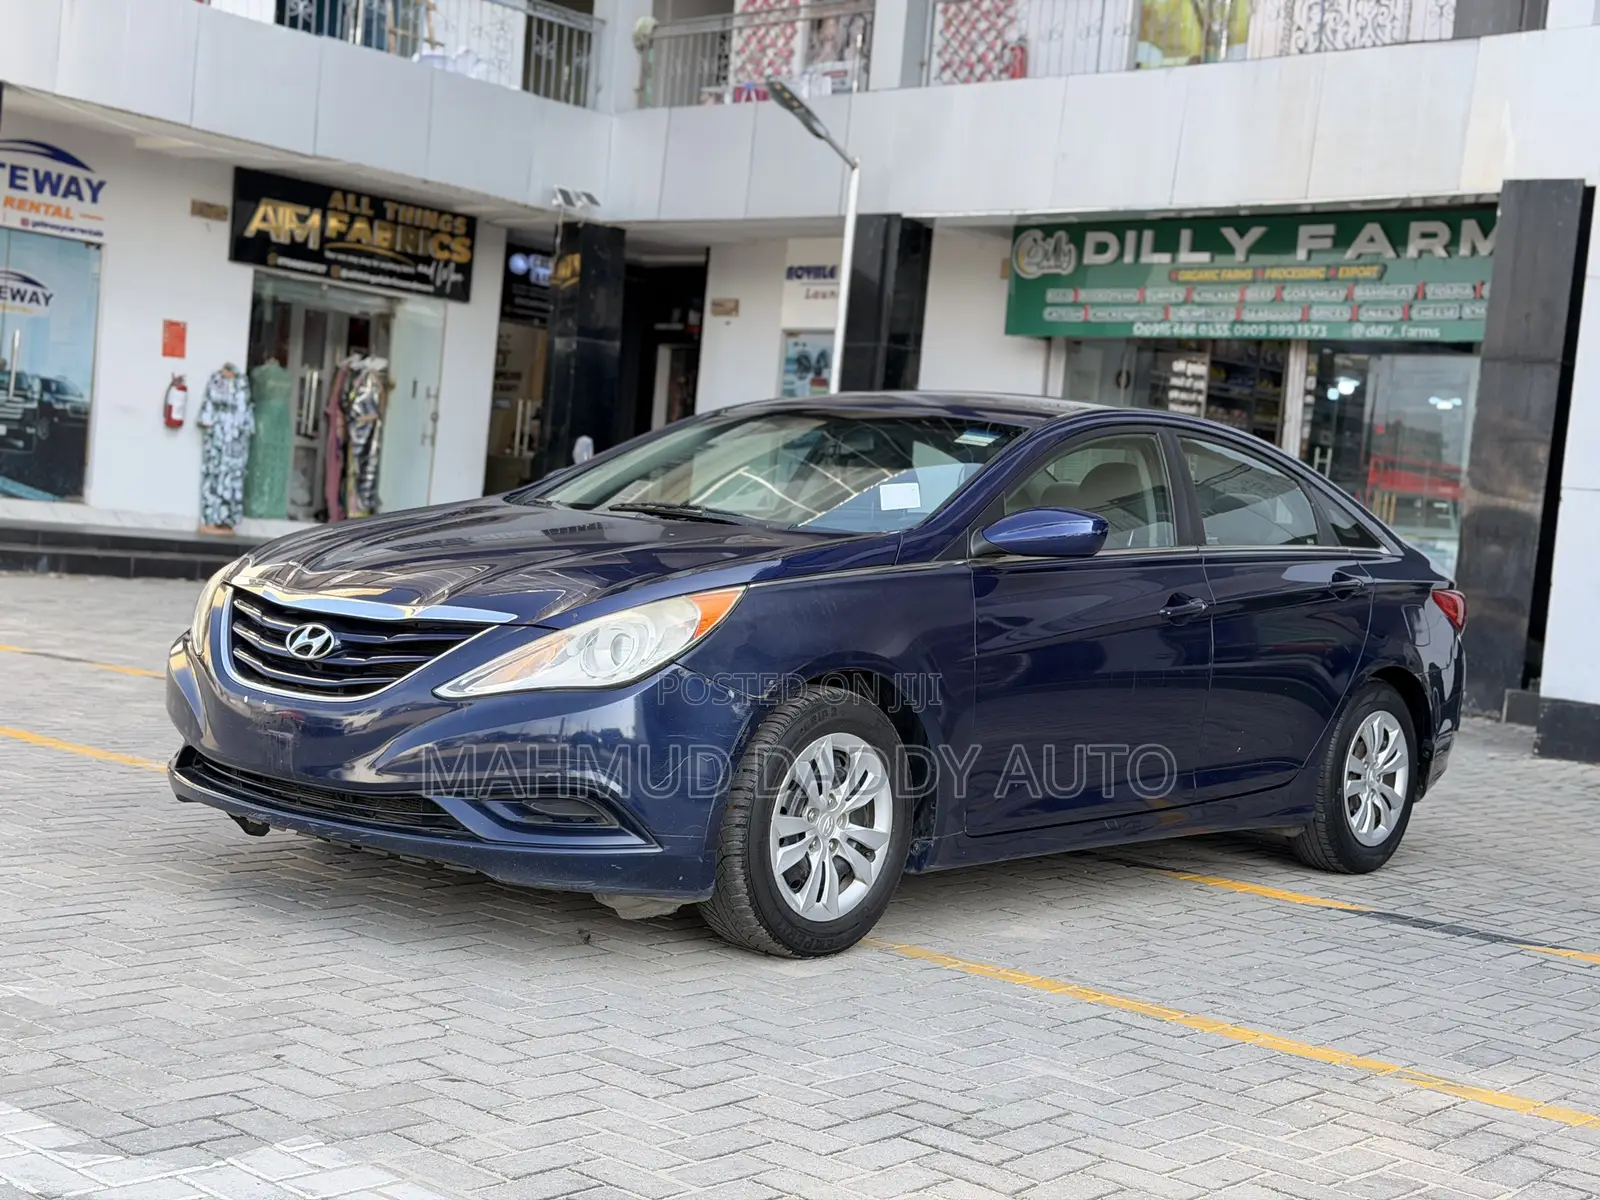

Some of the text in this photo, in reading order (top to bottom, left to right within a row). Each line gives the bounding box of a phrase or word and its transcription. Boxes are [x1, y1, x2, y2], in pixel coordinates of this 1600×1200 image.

[3, 194, 74, 221] RENTAL
[328, 190, 468, 235] ALL THINGS
[324, 210, 471, 263] FABRICS
[1082, 225, 1268, 265] DILLY
[804, 288, 838, 299] Loun
[1297, 323, 1327, 336] 1573
